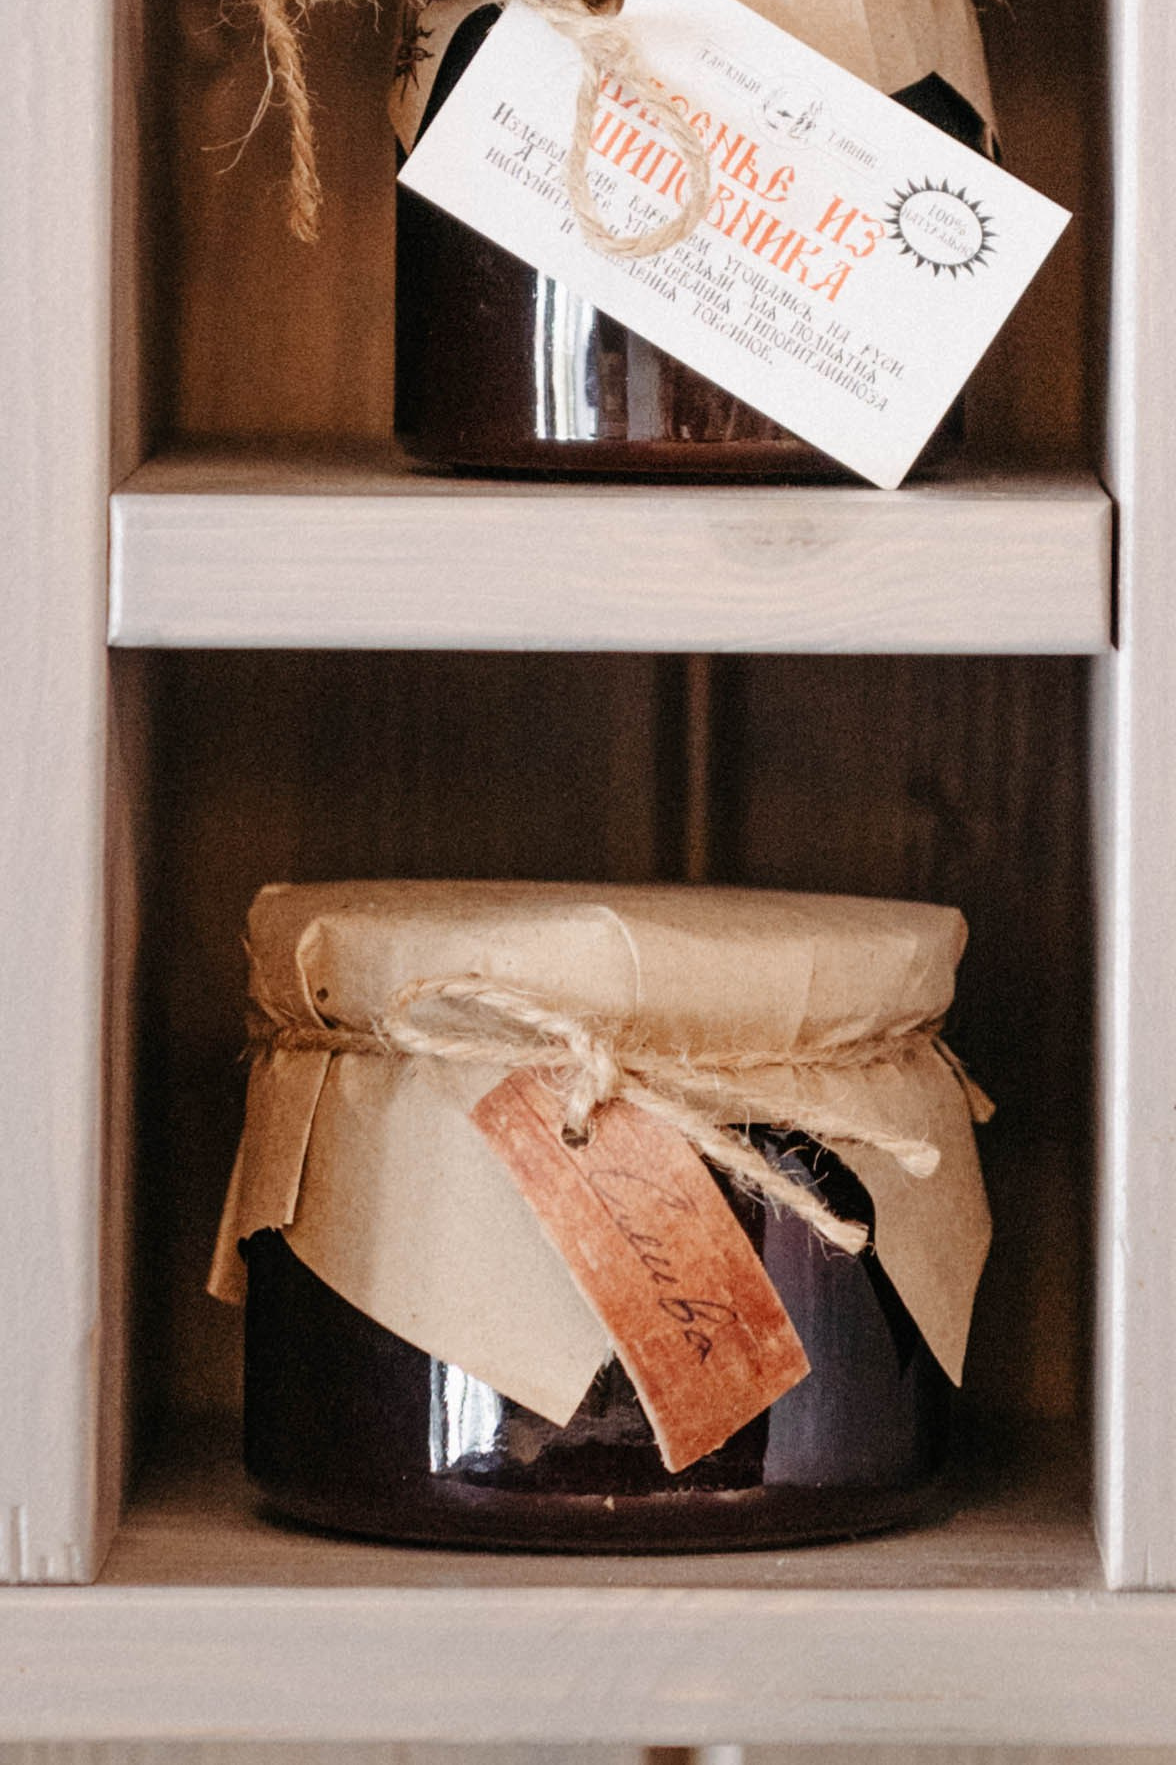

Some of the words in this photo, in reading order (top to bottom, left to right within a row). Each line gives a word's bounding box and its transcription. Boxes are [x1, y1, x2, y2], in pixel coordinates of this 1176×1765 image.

[490, 101, 573, 164] ИЗДРЕВЛ
[718, 254, 817, 326] УГОЩАЛИСЬ
[824, 320, 852, 344] НА
[512, 138, 535, 162] А
[743, 291, 781, 323] ДЛЯ
[788, 319, 881, 386] ПОДНЯТИЯ
[812, 194, 889, 264] ИЗ
[741, 312, 889, 412] ГИПОВИТАМИНОЗА
